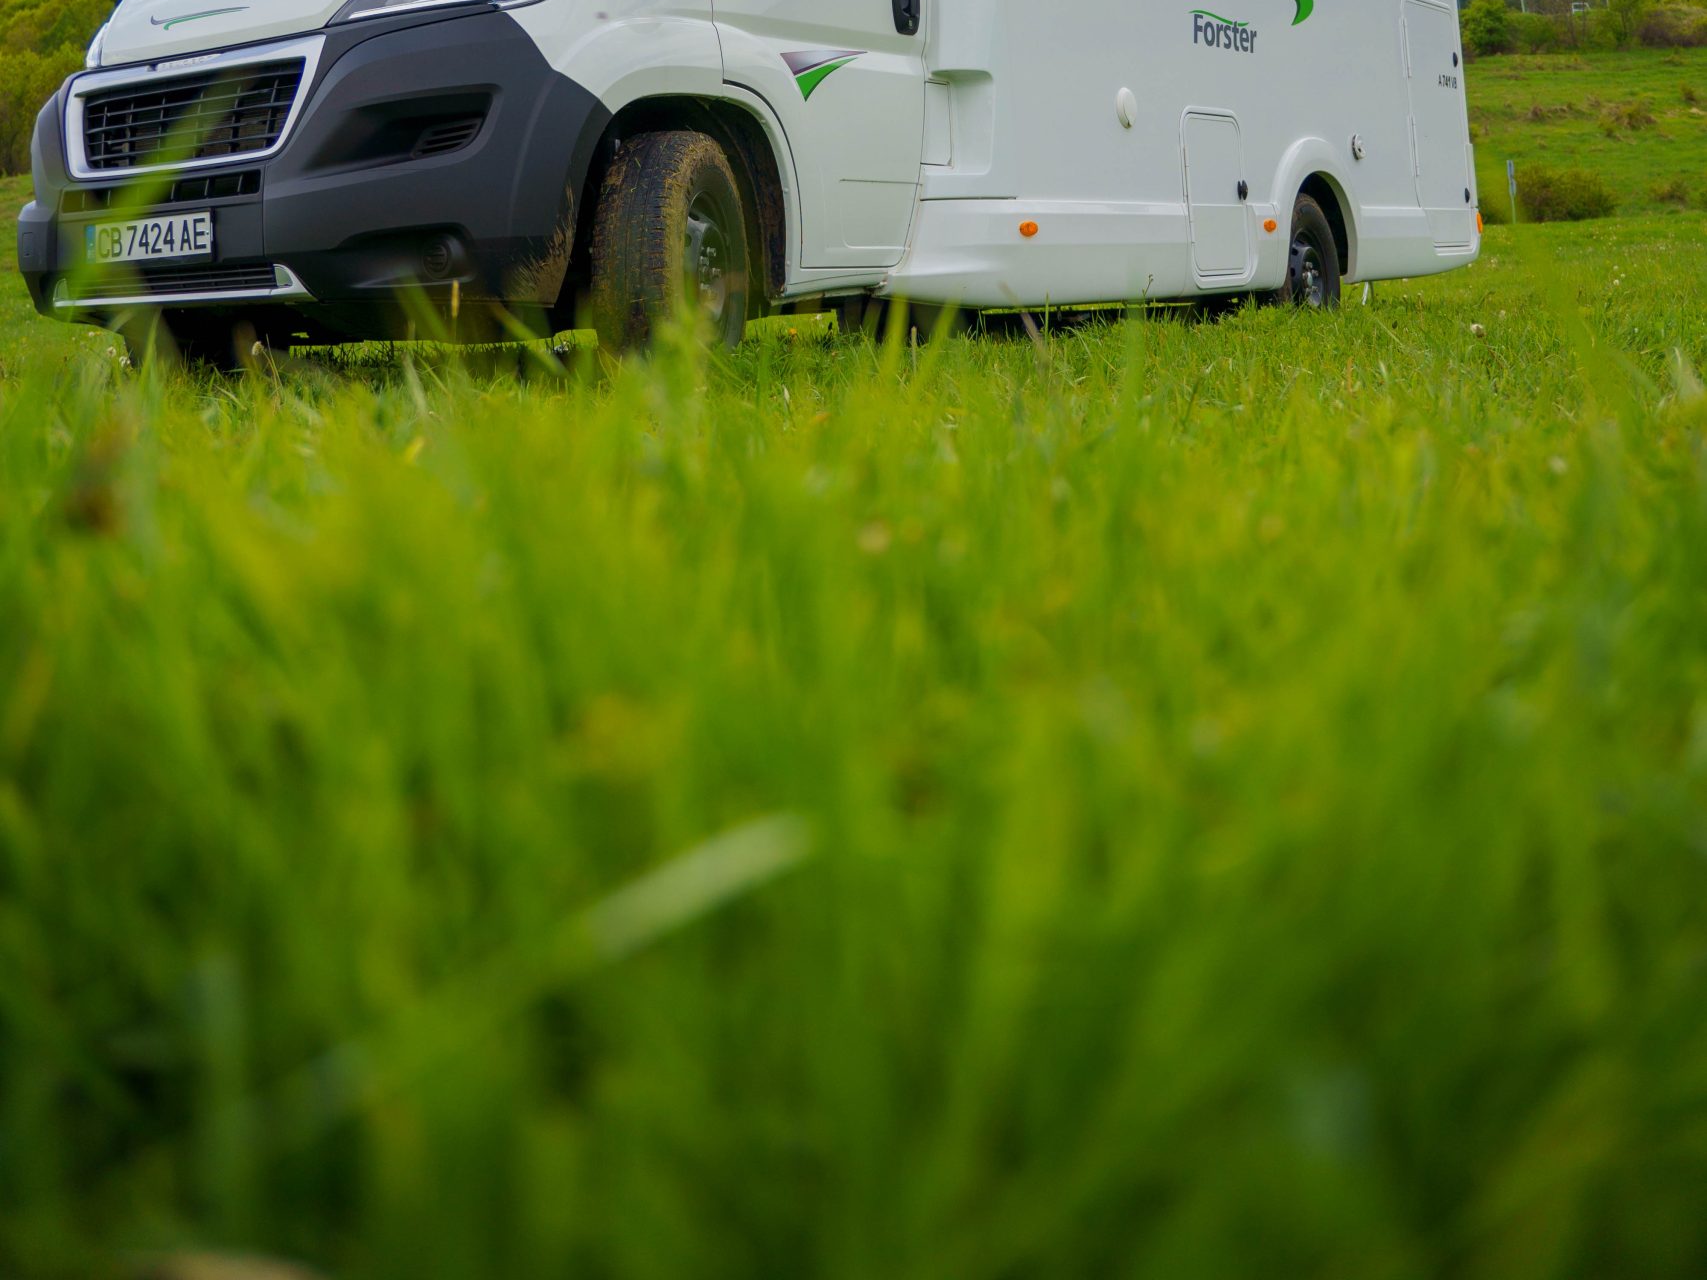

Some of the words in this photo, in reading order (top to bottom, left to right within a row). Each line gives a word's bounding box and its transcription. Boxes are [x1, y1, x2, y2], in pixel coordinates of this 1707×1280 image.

[1193, 13, 1257, 53] Forster
[98, 227, 122, 258] CB
[126, 221, 174, 256] 7424
[180, 218, 207, 251] AE
